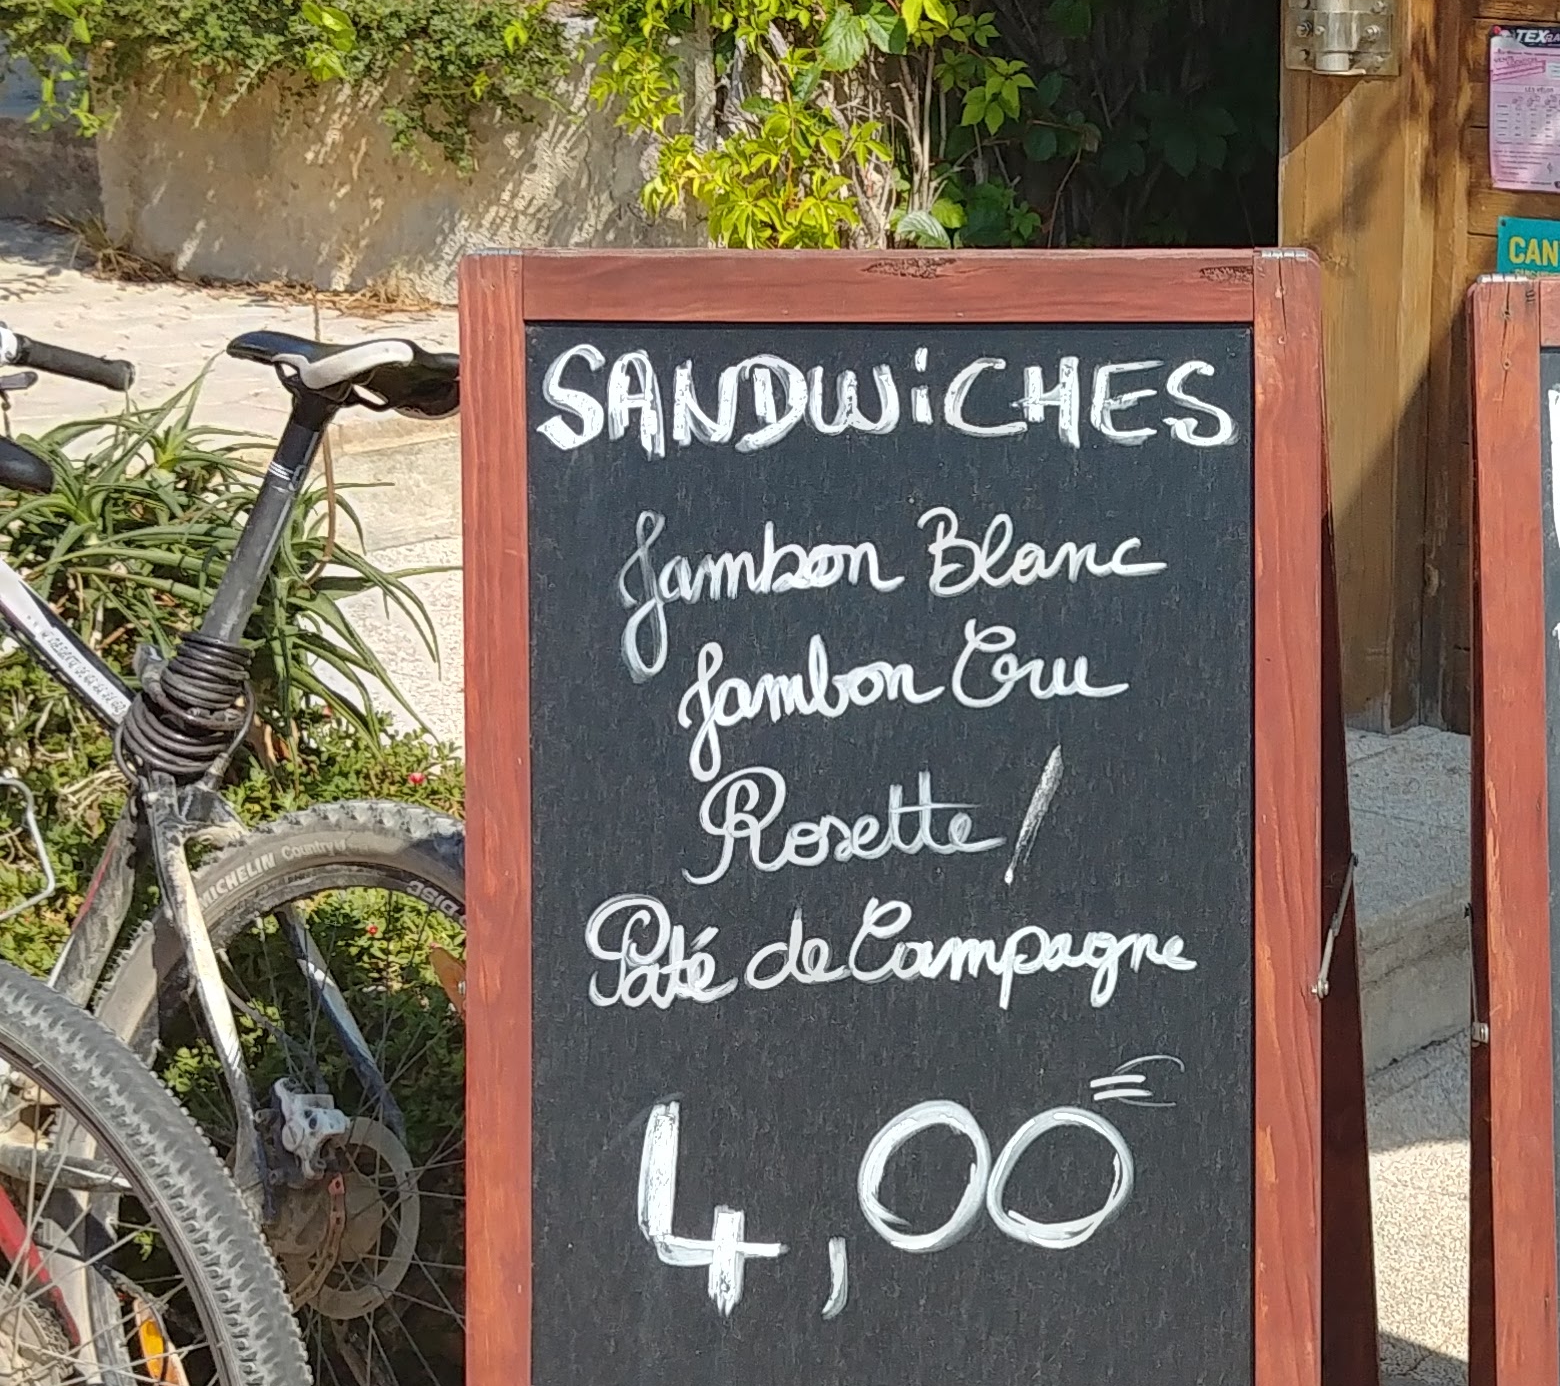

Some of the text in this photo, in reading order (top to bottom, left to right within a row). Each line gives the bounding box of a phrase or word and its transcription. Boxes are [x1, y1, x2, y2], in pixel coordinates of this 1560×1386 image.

[1516, 28, 1549, 44] TEX
[618, 506, 1167, 684] Jambon Blanc
[678, 618, 1129, 781] Jambon Cru
[198, 840, 336, 910] MICHELIN Country
[681, 766, 1007, 886] Rosette
[744, 905, 852, 991] de
[848, 895, 1198, 1009] Campagne
